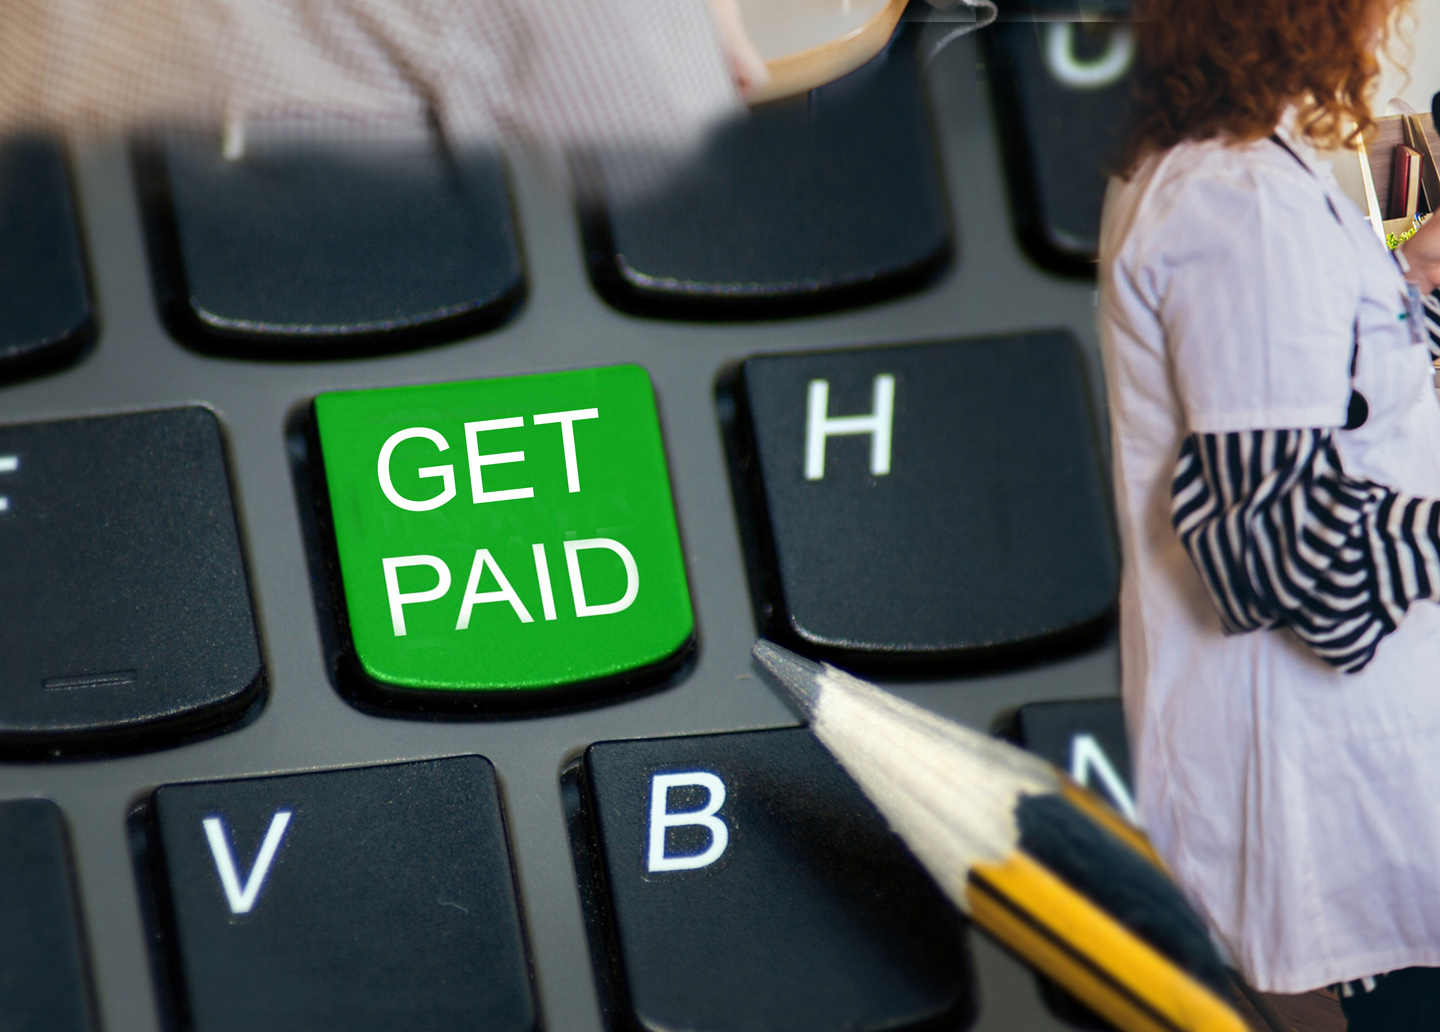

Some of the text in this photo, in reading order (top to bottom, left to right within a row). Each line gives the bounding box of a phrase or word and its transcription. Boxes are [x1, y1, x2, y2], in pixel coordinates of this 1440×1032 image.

[376, 407, 599, 511] GET
[805, 375, 895, 480] H
[381, 537, 640, 637] PAID
[202, 811, 292, 914] V
[645, 770, 729, 882] B
